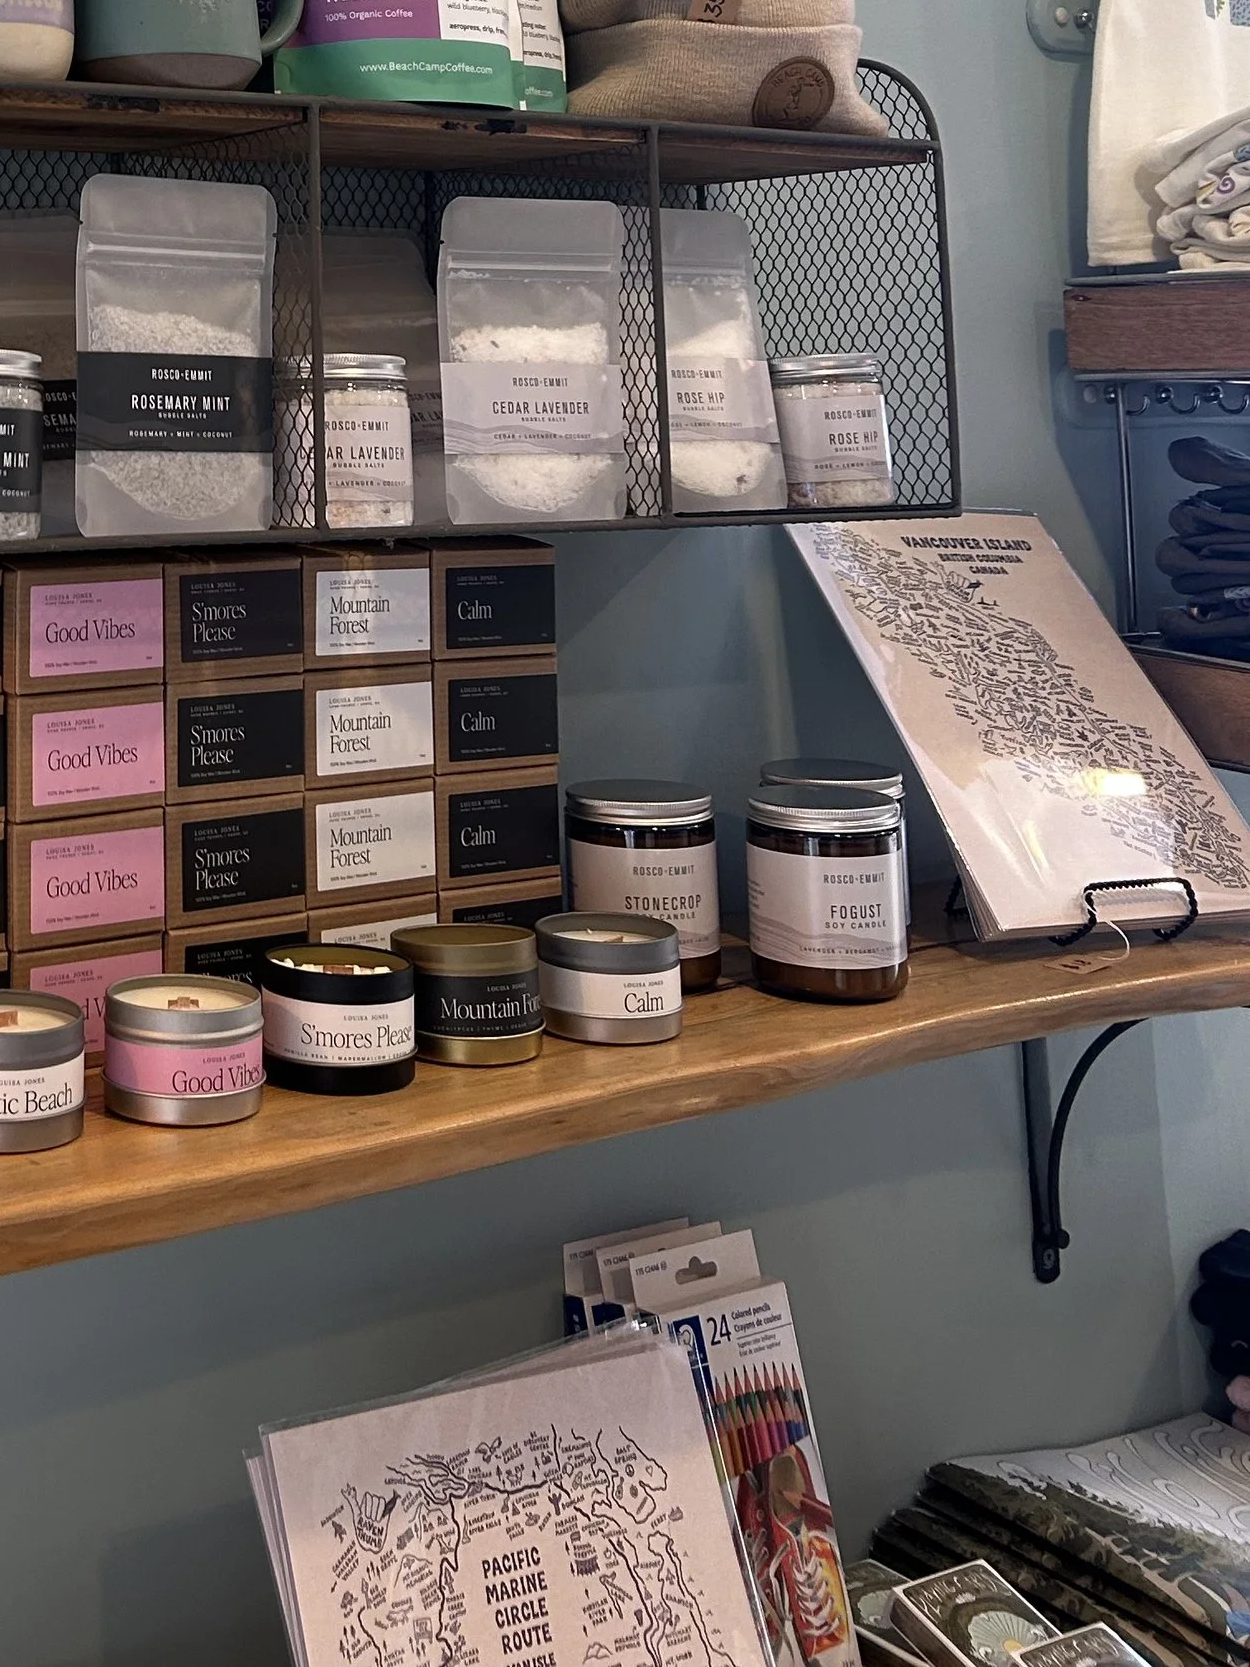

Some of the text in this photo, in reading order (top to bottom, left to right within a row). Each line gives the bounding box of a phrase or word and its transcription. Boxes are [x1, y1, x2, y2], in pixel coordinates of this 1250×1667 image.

[325, 9, 413, 22] 100% Organic Coffee
[359, 61, 493, 76] www.BeachCampCoffee.com
[131, 394, 230, 411] ROSEMARY MINT
[492, 401, 590, 415] CEDAR LAVENDER
[677, 392, 725, 404] ROSE HIP
[829, 431, 879, 445] ROSE HIP
[3, 452, 30, 468] MINT
[351, 446, 406, 460] LAVENDER
[900, 536, 1032, 551] VANCOUVER ISLAND
[969, 566, 1009, 575] CANADA
[191, 601, 246, 623] S'mores
[329, 595, 390, 615] Mountain
[457, 600, 492, 621] Calm
[45, 618, 136, 644] Good Vibes
[192, 622, 236, 643] Please
[329, 616, 370, 636] Forest
[329, 712, 392, 733] Mountain
[461, 712, 496, 732] Calm
[190, 724, 245, 746] S'mores
[329, 733, 371, 753] Forest
[47, 743, 138, 772] Good Vibes
[190, 745, 234, 767] Please
[329, 823, 392, 848] Mountain
[460, 825, 496, 848] Calm
[194, 846, 250, 870] S'mores
[329, 846, 372, 870] Forest
[46, 868, 138, 898] Good Vibes
[195, 867, 239, 891] Please
[625, 894, 702, 911] STONECROP
[830, 903, 882, 921] FOGUST
[659, 912, 697, 921] CANDLE
[825, 919, 887, 929] SOY CANDLE
[440, 992, 520, 1021] Mountain
[624, 992, 664, 1015] Calm
[300, 1021, 412, 1051] S'mores Please
[171, 1061, 262, 1094] Good Vibes
[24, 1082, 73, 1115] Beach
[707, 1314, 731, 1346] 24
[731, 1307, 752, 1320] Colored
[753, 1303, 771, 1315] pencils
[734, 1314, 782, 1332] Crayons de couleur
[357, 1516, 384, 1536] RAVEN
[357, 1527, 383, 1549] THUMB
[482, 1546, 541, 1579] PACIFIC
[485, 1571, 548, 1605] MARINE
[495, 1597, 549, 1629] CIRCLE
[502, 1622, 553, 1655] ROUTE
